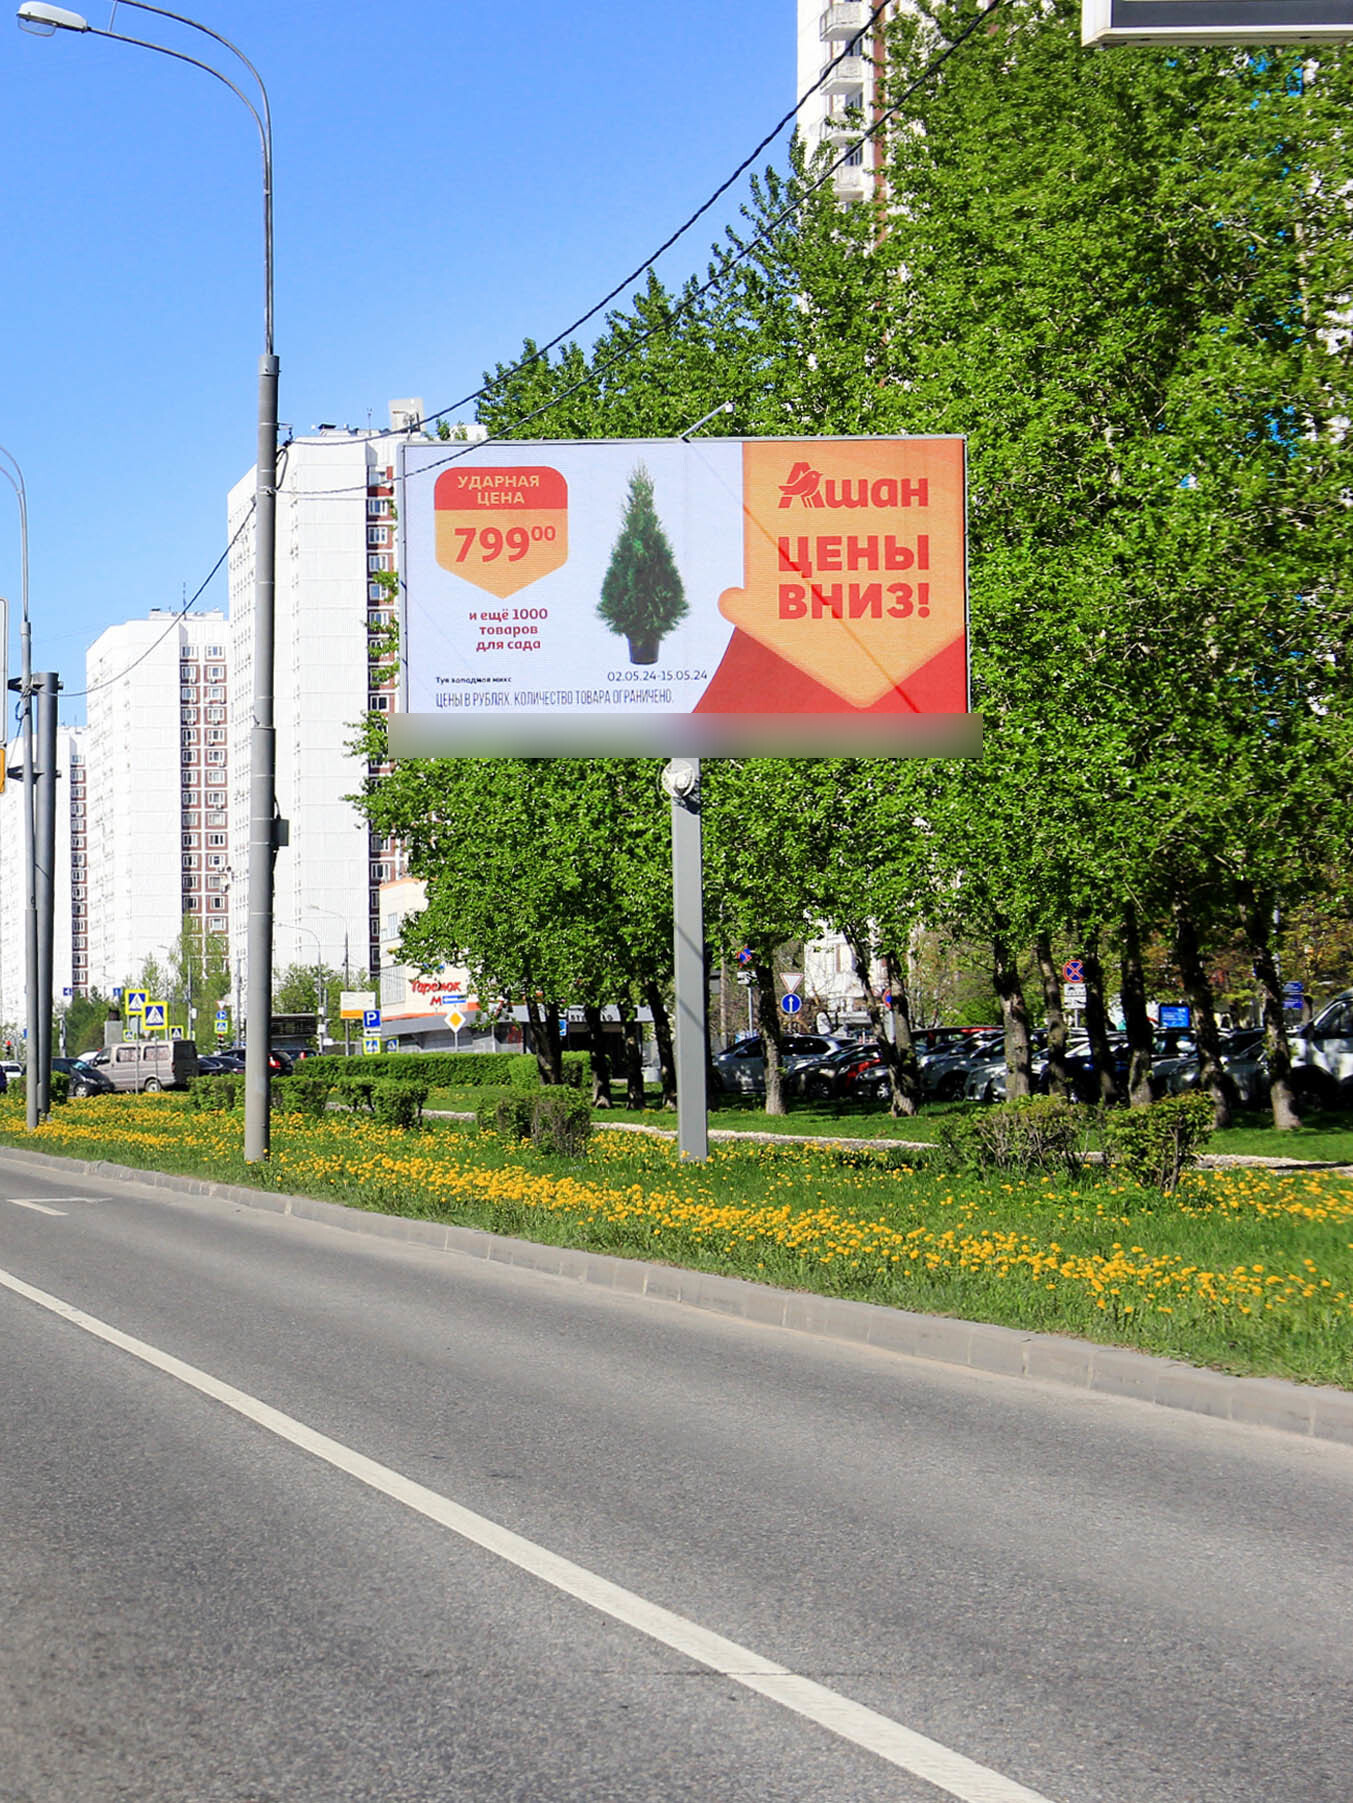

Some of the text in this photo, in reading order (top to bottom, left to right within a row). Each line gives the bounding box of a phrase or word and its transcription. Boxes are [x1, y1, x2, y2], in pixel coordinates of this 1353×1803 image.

[456, 475, 540, 491] УДАРНАЯ
[778, 461, 929, 509] Ашан
[476, 491, 526, 507] ЦЕНА
[778, 534, 930, 579] ЦЕНЫ
[778, 582, 931, 620] ВНИЗ!
[468, 607, 549, 623] и ещё 1000
[479, 625, 539, 638] товаров
[475, 639, 542, 653] для сада
[606, 669, 708, 682] 02.05.24-15.05.24
[435, 692, 464, 709] ЦЕНЫ
[464, 692, 471, 707] В
[514, 690, 574, 706] КОЛИЧЕСТВО
[576, 689, 611, 705] ТОВАРА
[367, 1012, 377, 1026] P
